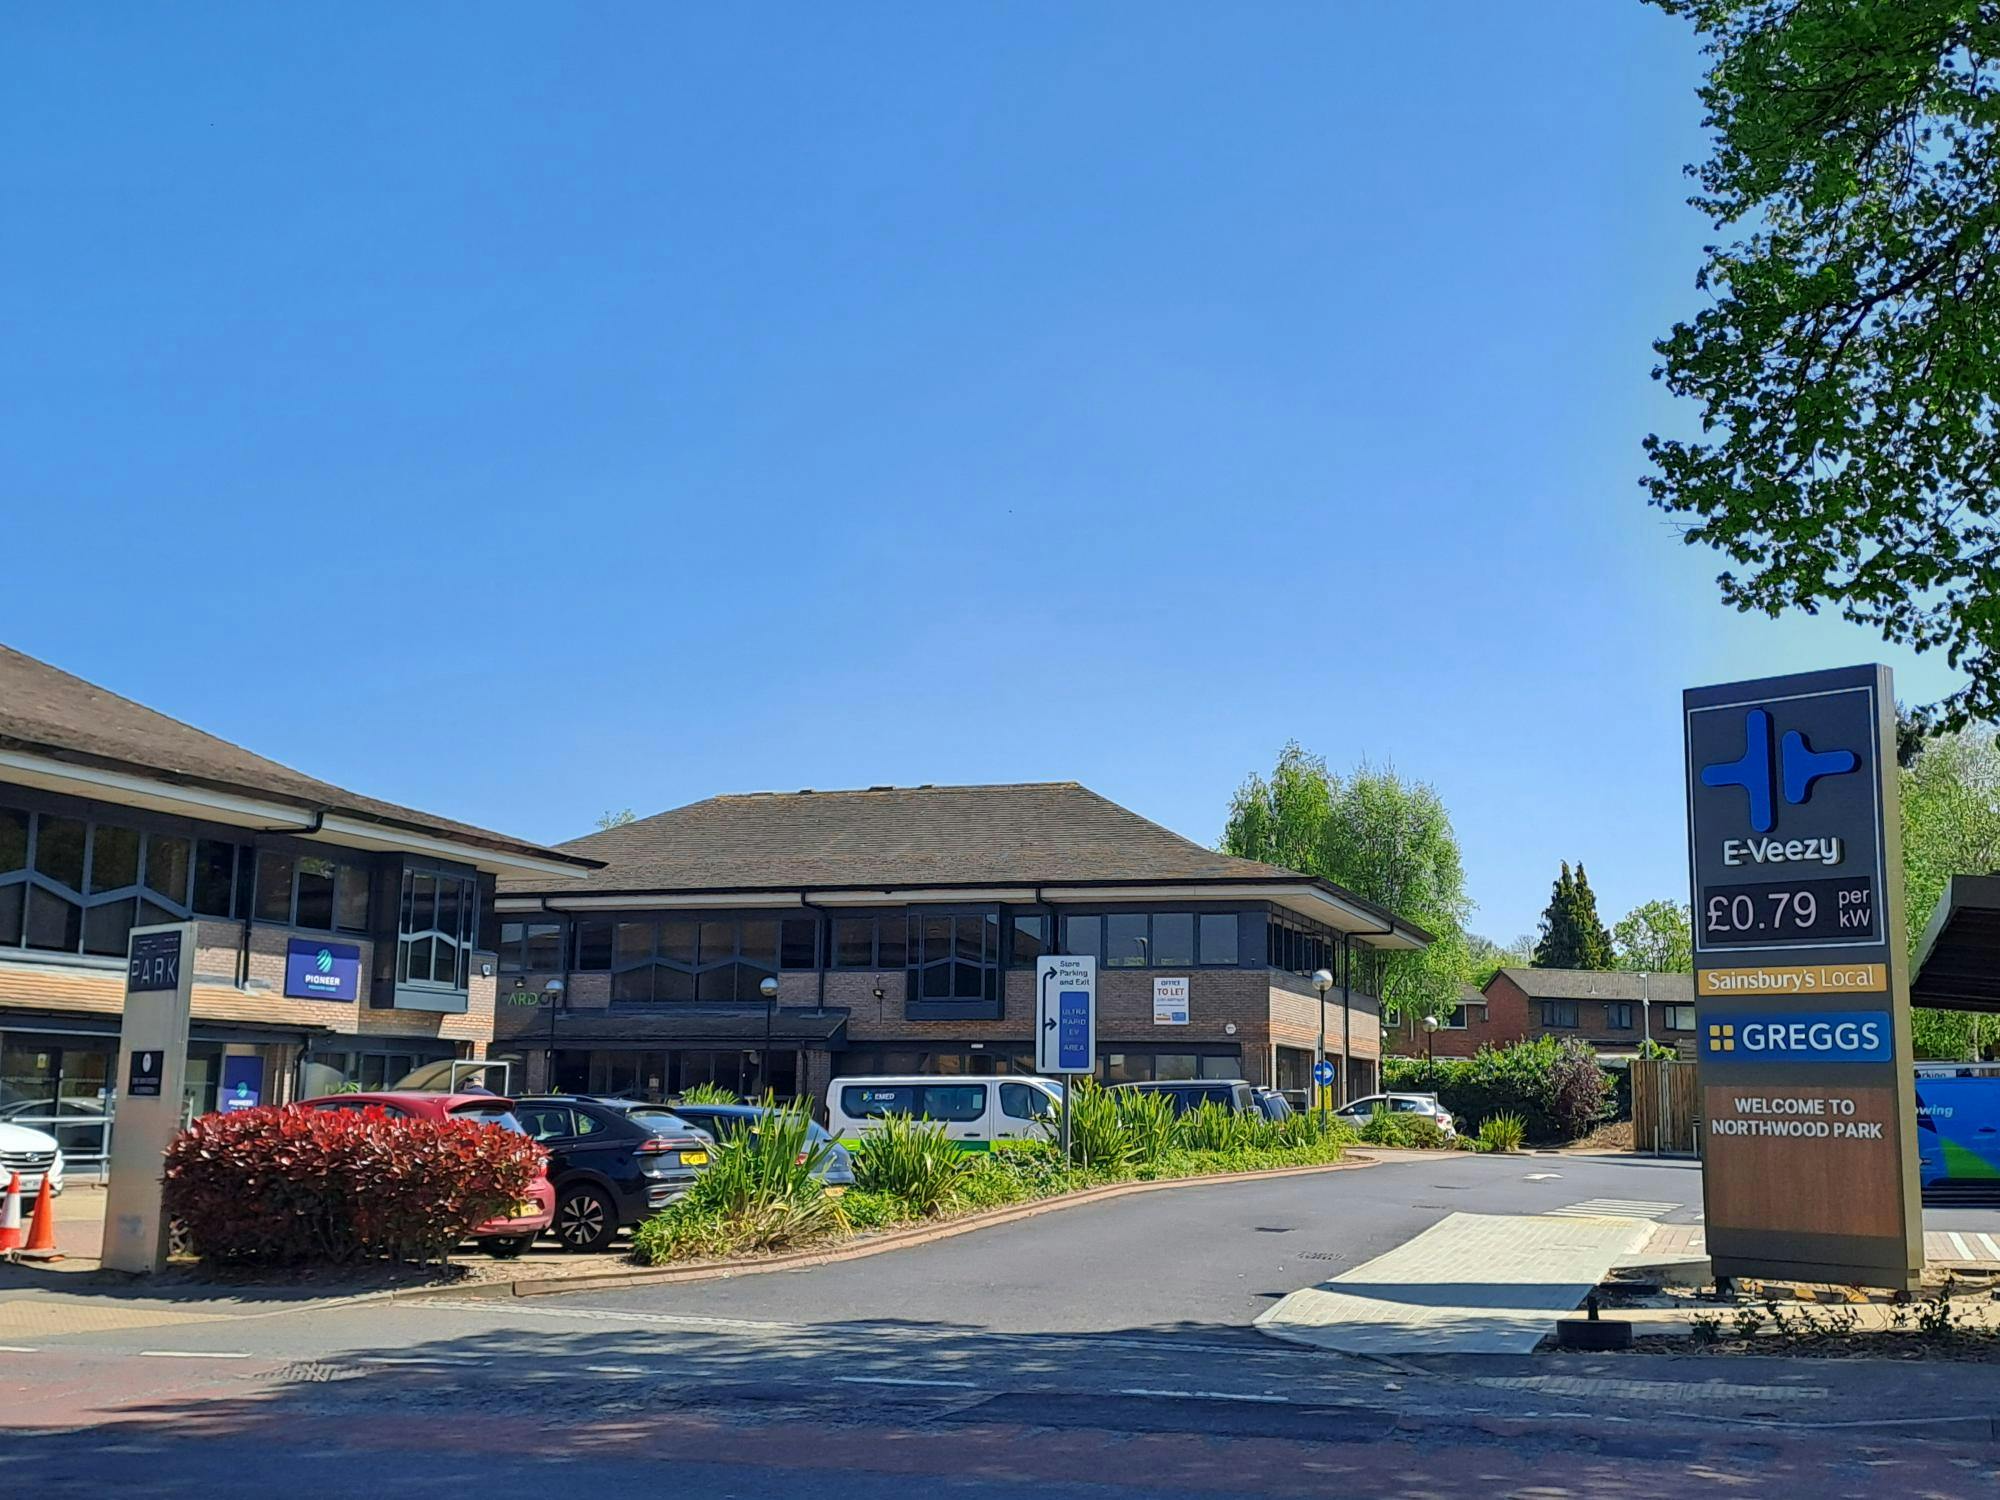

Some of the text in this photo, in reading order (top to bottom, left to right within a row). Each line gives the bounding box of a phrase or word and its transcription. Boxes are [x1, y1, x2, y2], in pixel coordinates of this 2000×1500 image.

[1723, 837, 1841, 866] E-Veezy
[1838, 889, 1870, 909] per
[1707, 891, 1817, 932] £0.79
[1839, 909, 1871, 928] kW
[131, 957, 177, 984] PARK
[305, 974, 341, 986] PIONEER
[1059, 968, 1088, 978] Parking
[1707, 965, 1875, 993] Sainsbury's Local
[1156, 987, 1185, 996] TO LET
[1742, 1022, 1880, 1051] GREGGS
[874, 1092, 896, 1101] EMED
[1734, 1097, 1856, 1115] WELCOME TO
[1711, 1119, 1884, 1139] NORTHWOOD PARK
